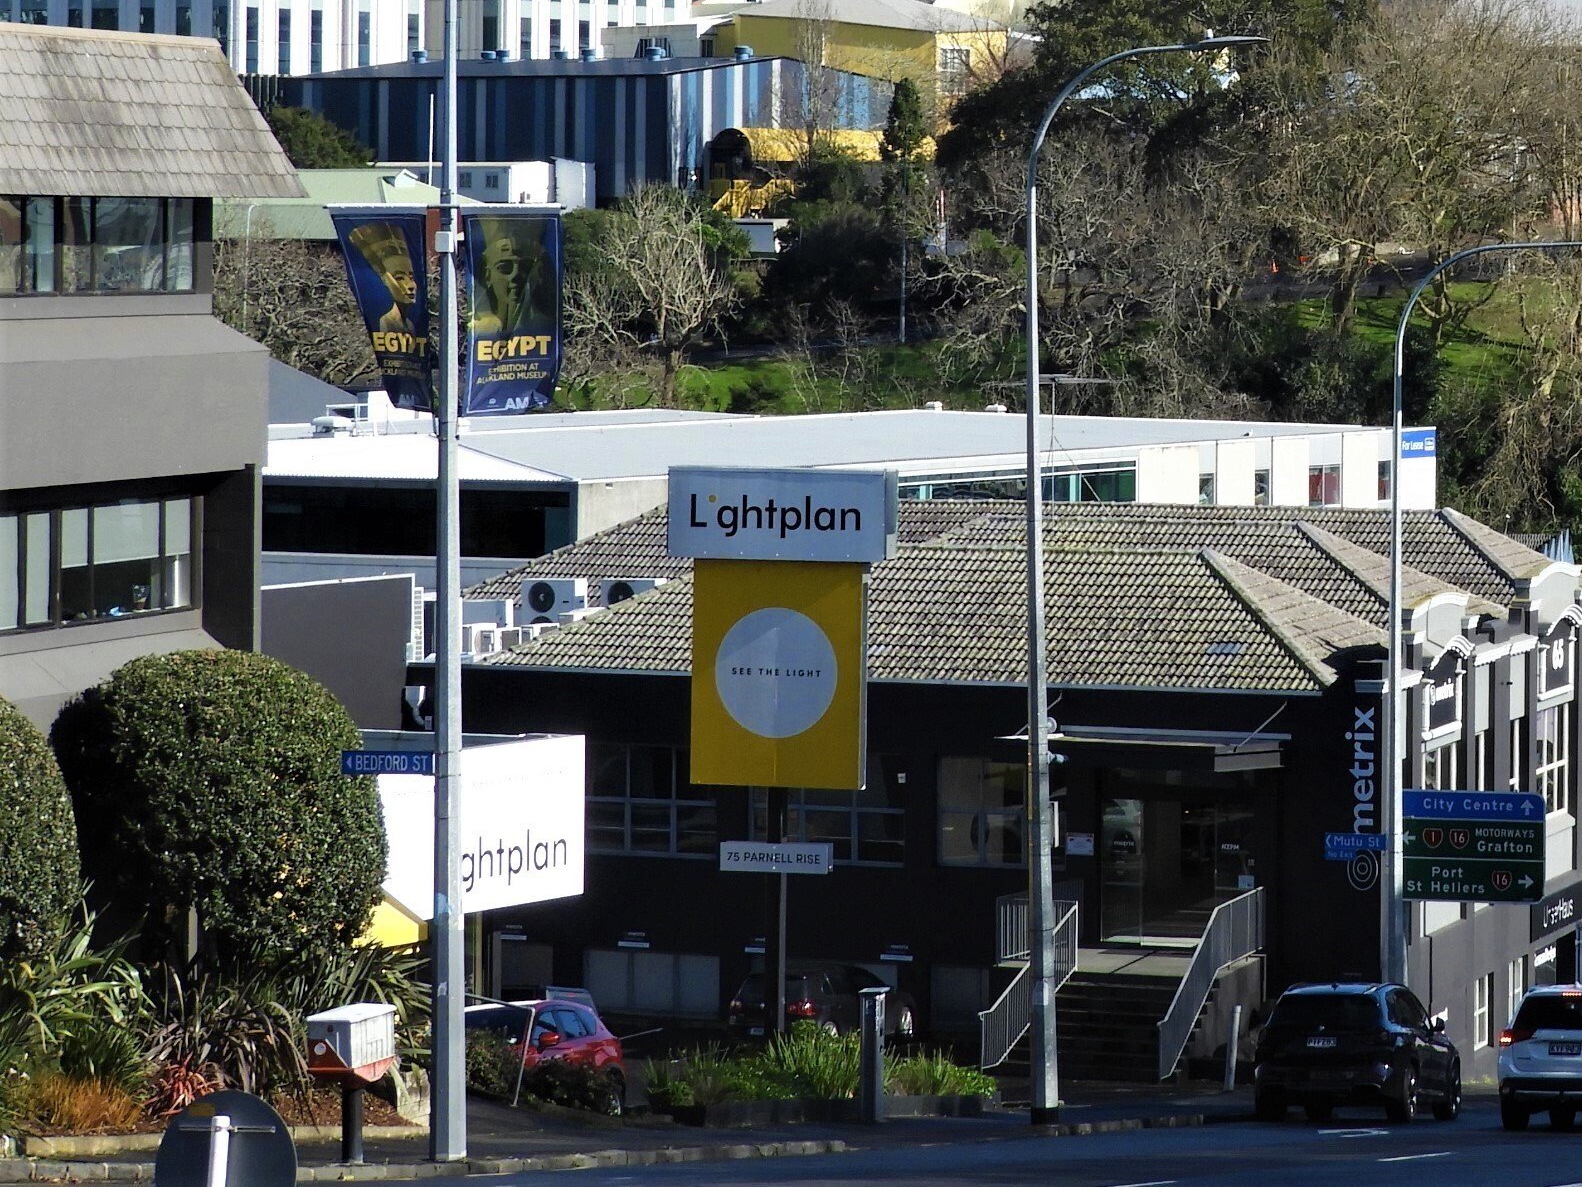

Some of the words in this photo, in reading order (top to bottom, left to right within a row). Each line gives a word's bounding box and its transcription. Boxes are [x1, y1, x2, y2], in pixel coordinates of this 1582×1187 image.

[477, 335, 552, 361] EGYPT
[528, 363, 539, 371] AT
[505, 397, 529, 409] AM
[1552, 639, 1564, 670] 65
[732, 667, 752, 675] SEE
[758, 668, 780, 676] THE
[786, 669, 821, 677] LIGHT
[355, 755, 408, 771] BEDFORD
[412, 755, 428, 771] ST
[1344, 706, 1375, 835] metrix
[1423, 798, 1454, 812] City
[1463, 799, 1514, 811] Centre
[1333, 836, 1363, 846] Mutu
[1368, 836, 1379, 847] St
[1431, 831, 1436, 843] 1
[1453, 832, 1465, 844] 16
[1475, 828, 1535, 838] MOTORWAYS
[1477, 841, 1533, 853] Grafton
[462, 829, 567, 892] ghtplan
[727, 851, 740, 862] 75
[743, 852, 793, 864] PARNELL
[796, 854, 820, 864] RISE
[1431, 866, 1464, 878] Port
[1496, 874, 1508, 886] 16
[1406, 880, 1422, 892] St
